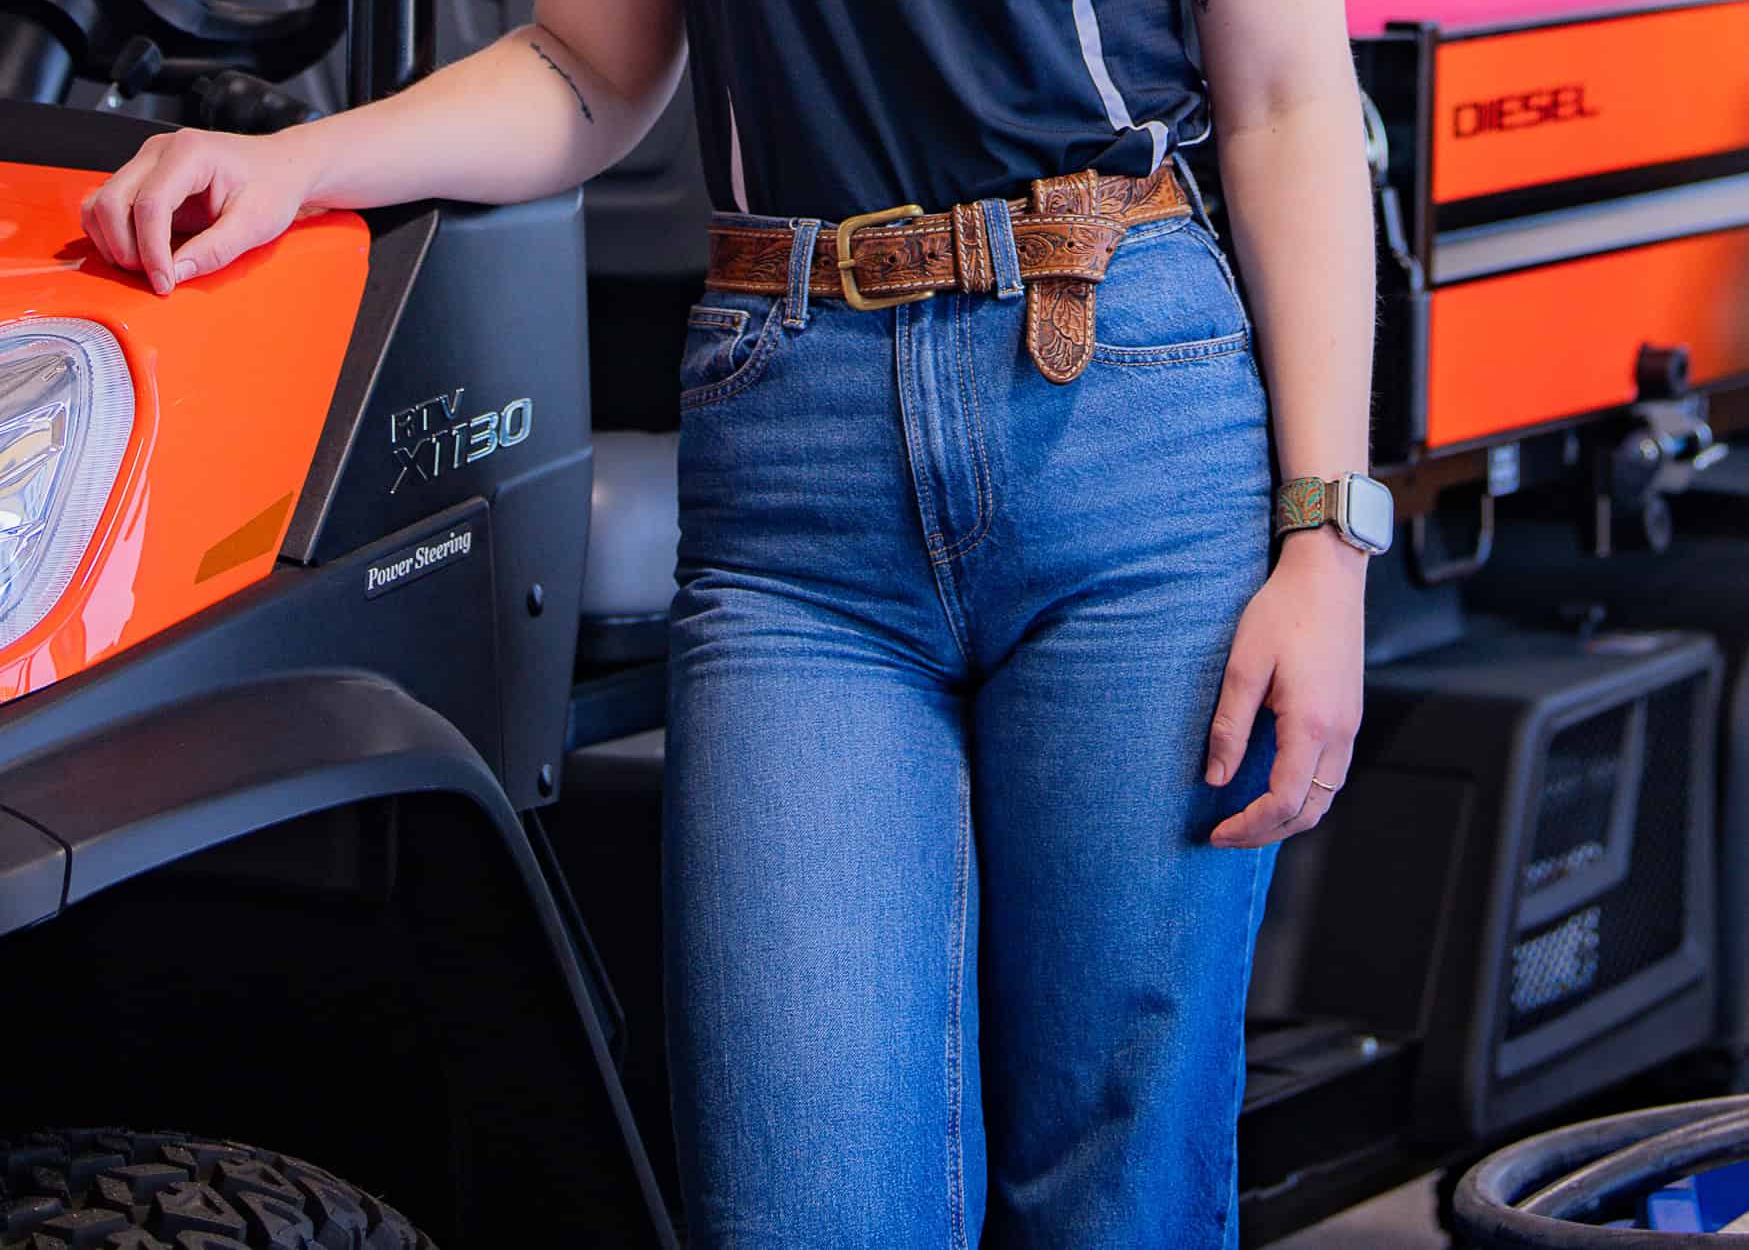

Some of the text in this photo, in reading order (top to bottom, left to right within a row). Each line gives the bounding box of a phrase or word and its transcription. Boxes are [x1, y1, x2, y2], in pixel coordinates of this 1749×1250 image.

[1454, 83, 1600, 139] DIESEL
[391, 387, 465, 443] RTV
[367, 531, 472, 591] Power Steering
